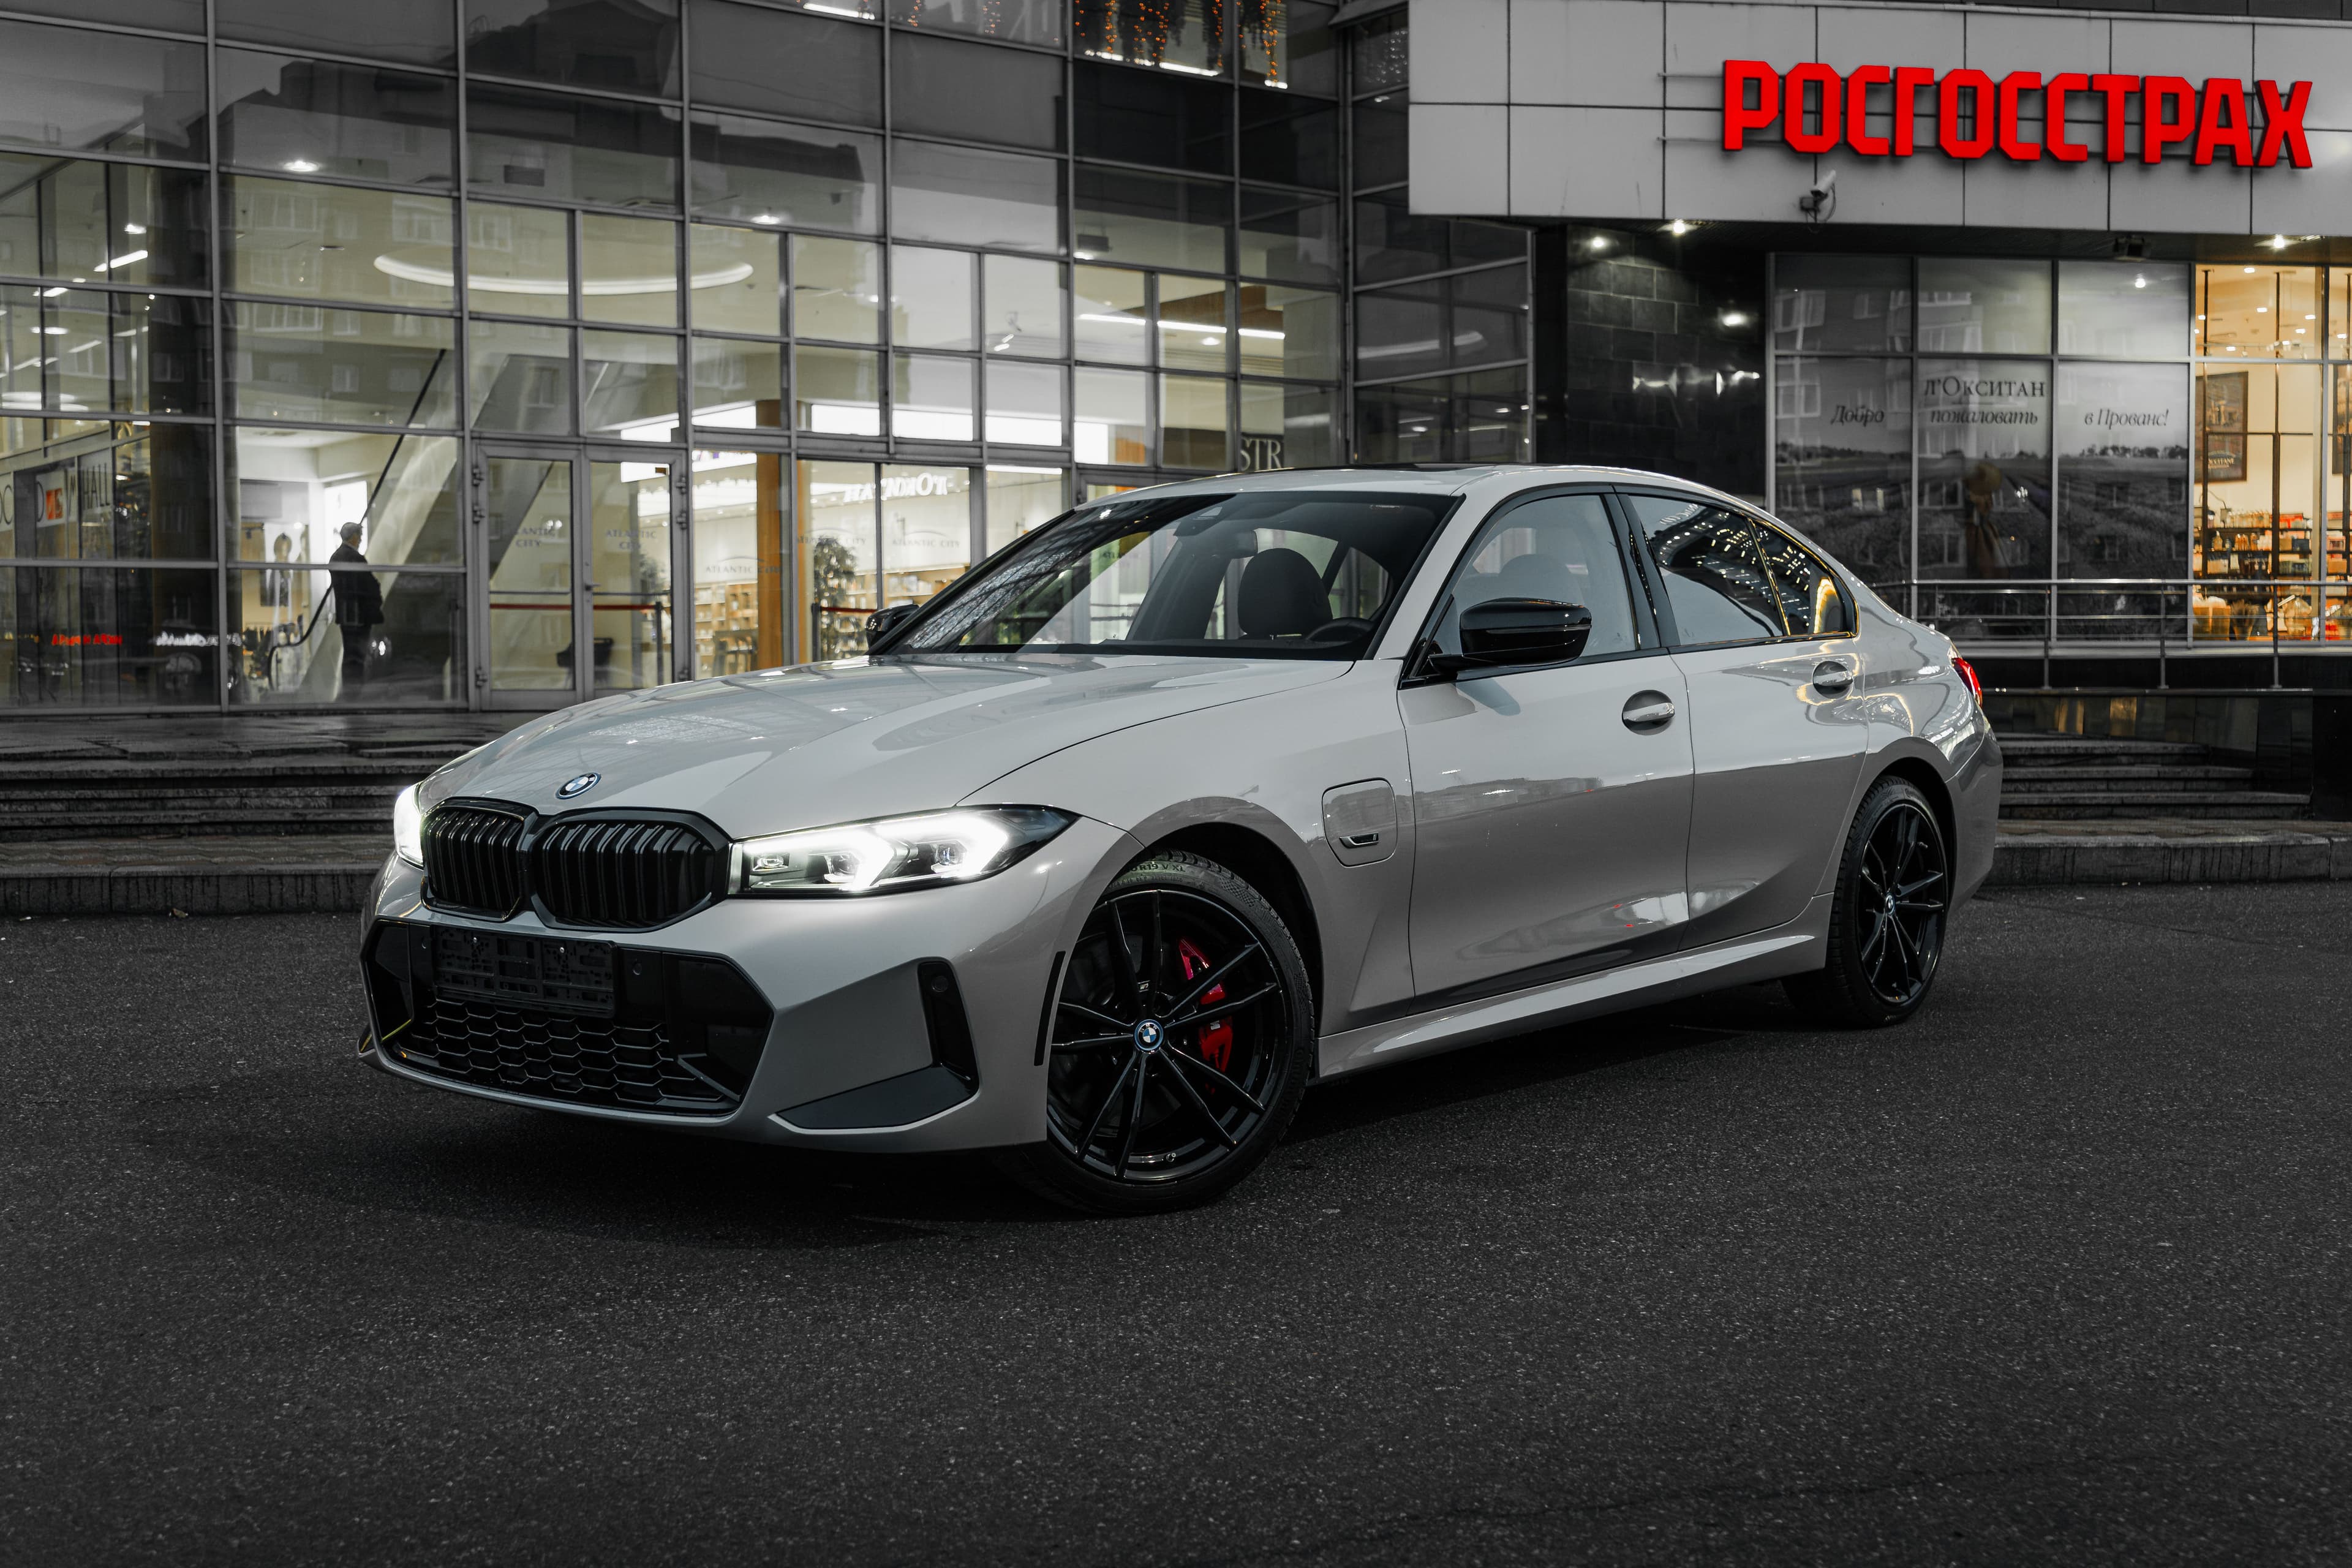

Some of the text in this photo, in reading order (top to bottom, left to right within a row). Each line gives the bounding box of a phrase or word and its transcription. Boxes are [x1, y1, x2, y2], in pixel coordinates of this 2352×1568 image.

[1724, 59, 2312, 168] РОСГОССТРАХ
[1830, 404, 2169, 429] Добро пожаловать в Прованс!
[705, 565, 752, 574] ATLANTIC
[1172, 864, 1186, 873] XL
